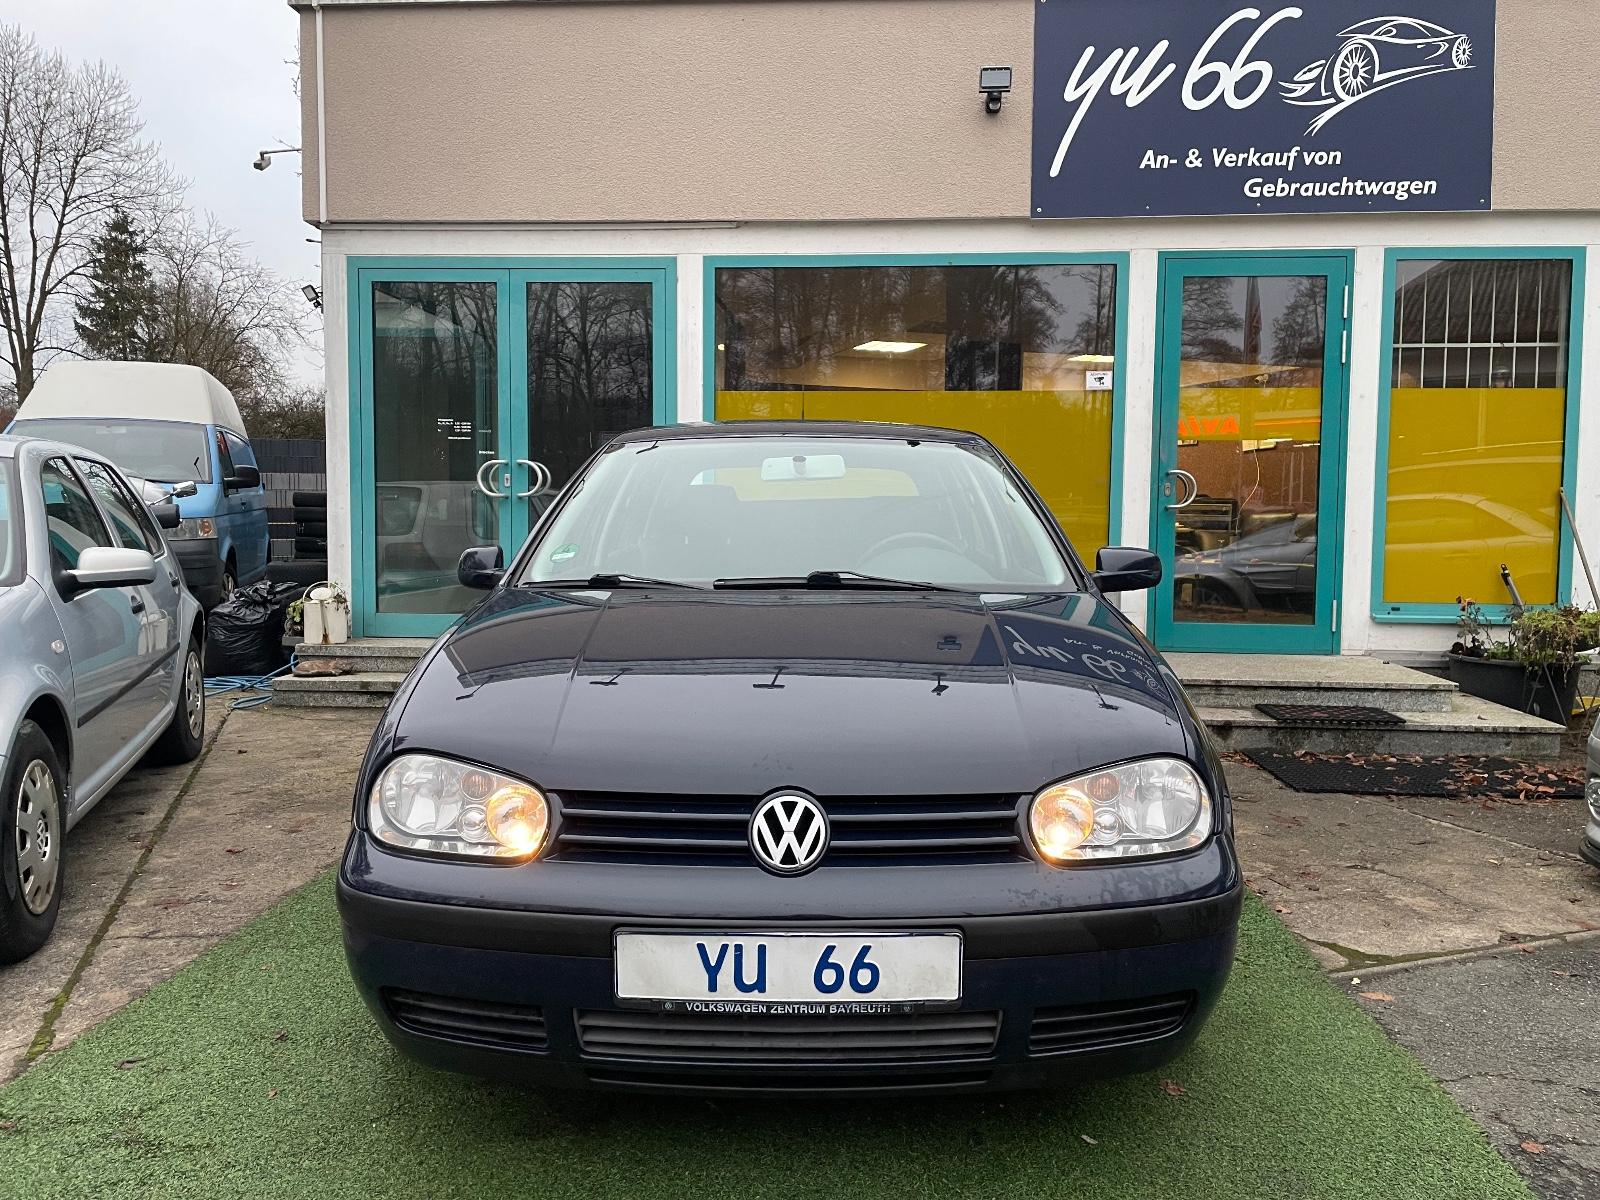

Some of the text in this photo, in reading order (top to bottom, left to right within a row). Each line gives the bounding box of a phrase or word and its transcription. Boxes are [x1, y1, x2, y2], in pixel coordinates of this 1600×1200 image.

[1050, 7, 1304, 178] yu 66
[1139, 146, 1342, 170] An- & Verkauf von
[1243, 177, 1437, 201] Gebrauchtwagen
[696, 943, 881, 994] YU 66
[685, 1002, 767, 1014] VOLKSWAGEN
[770, 1004, 826, 1014] ZENTRUM
[829, 1004, 891, 1014] BAYREUTH
